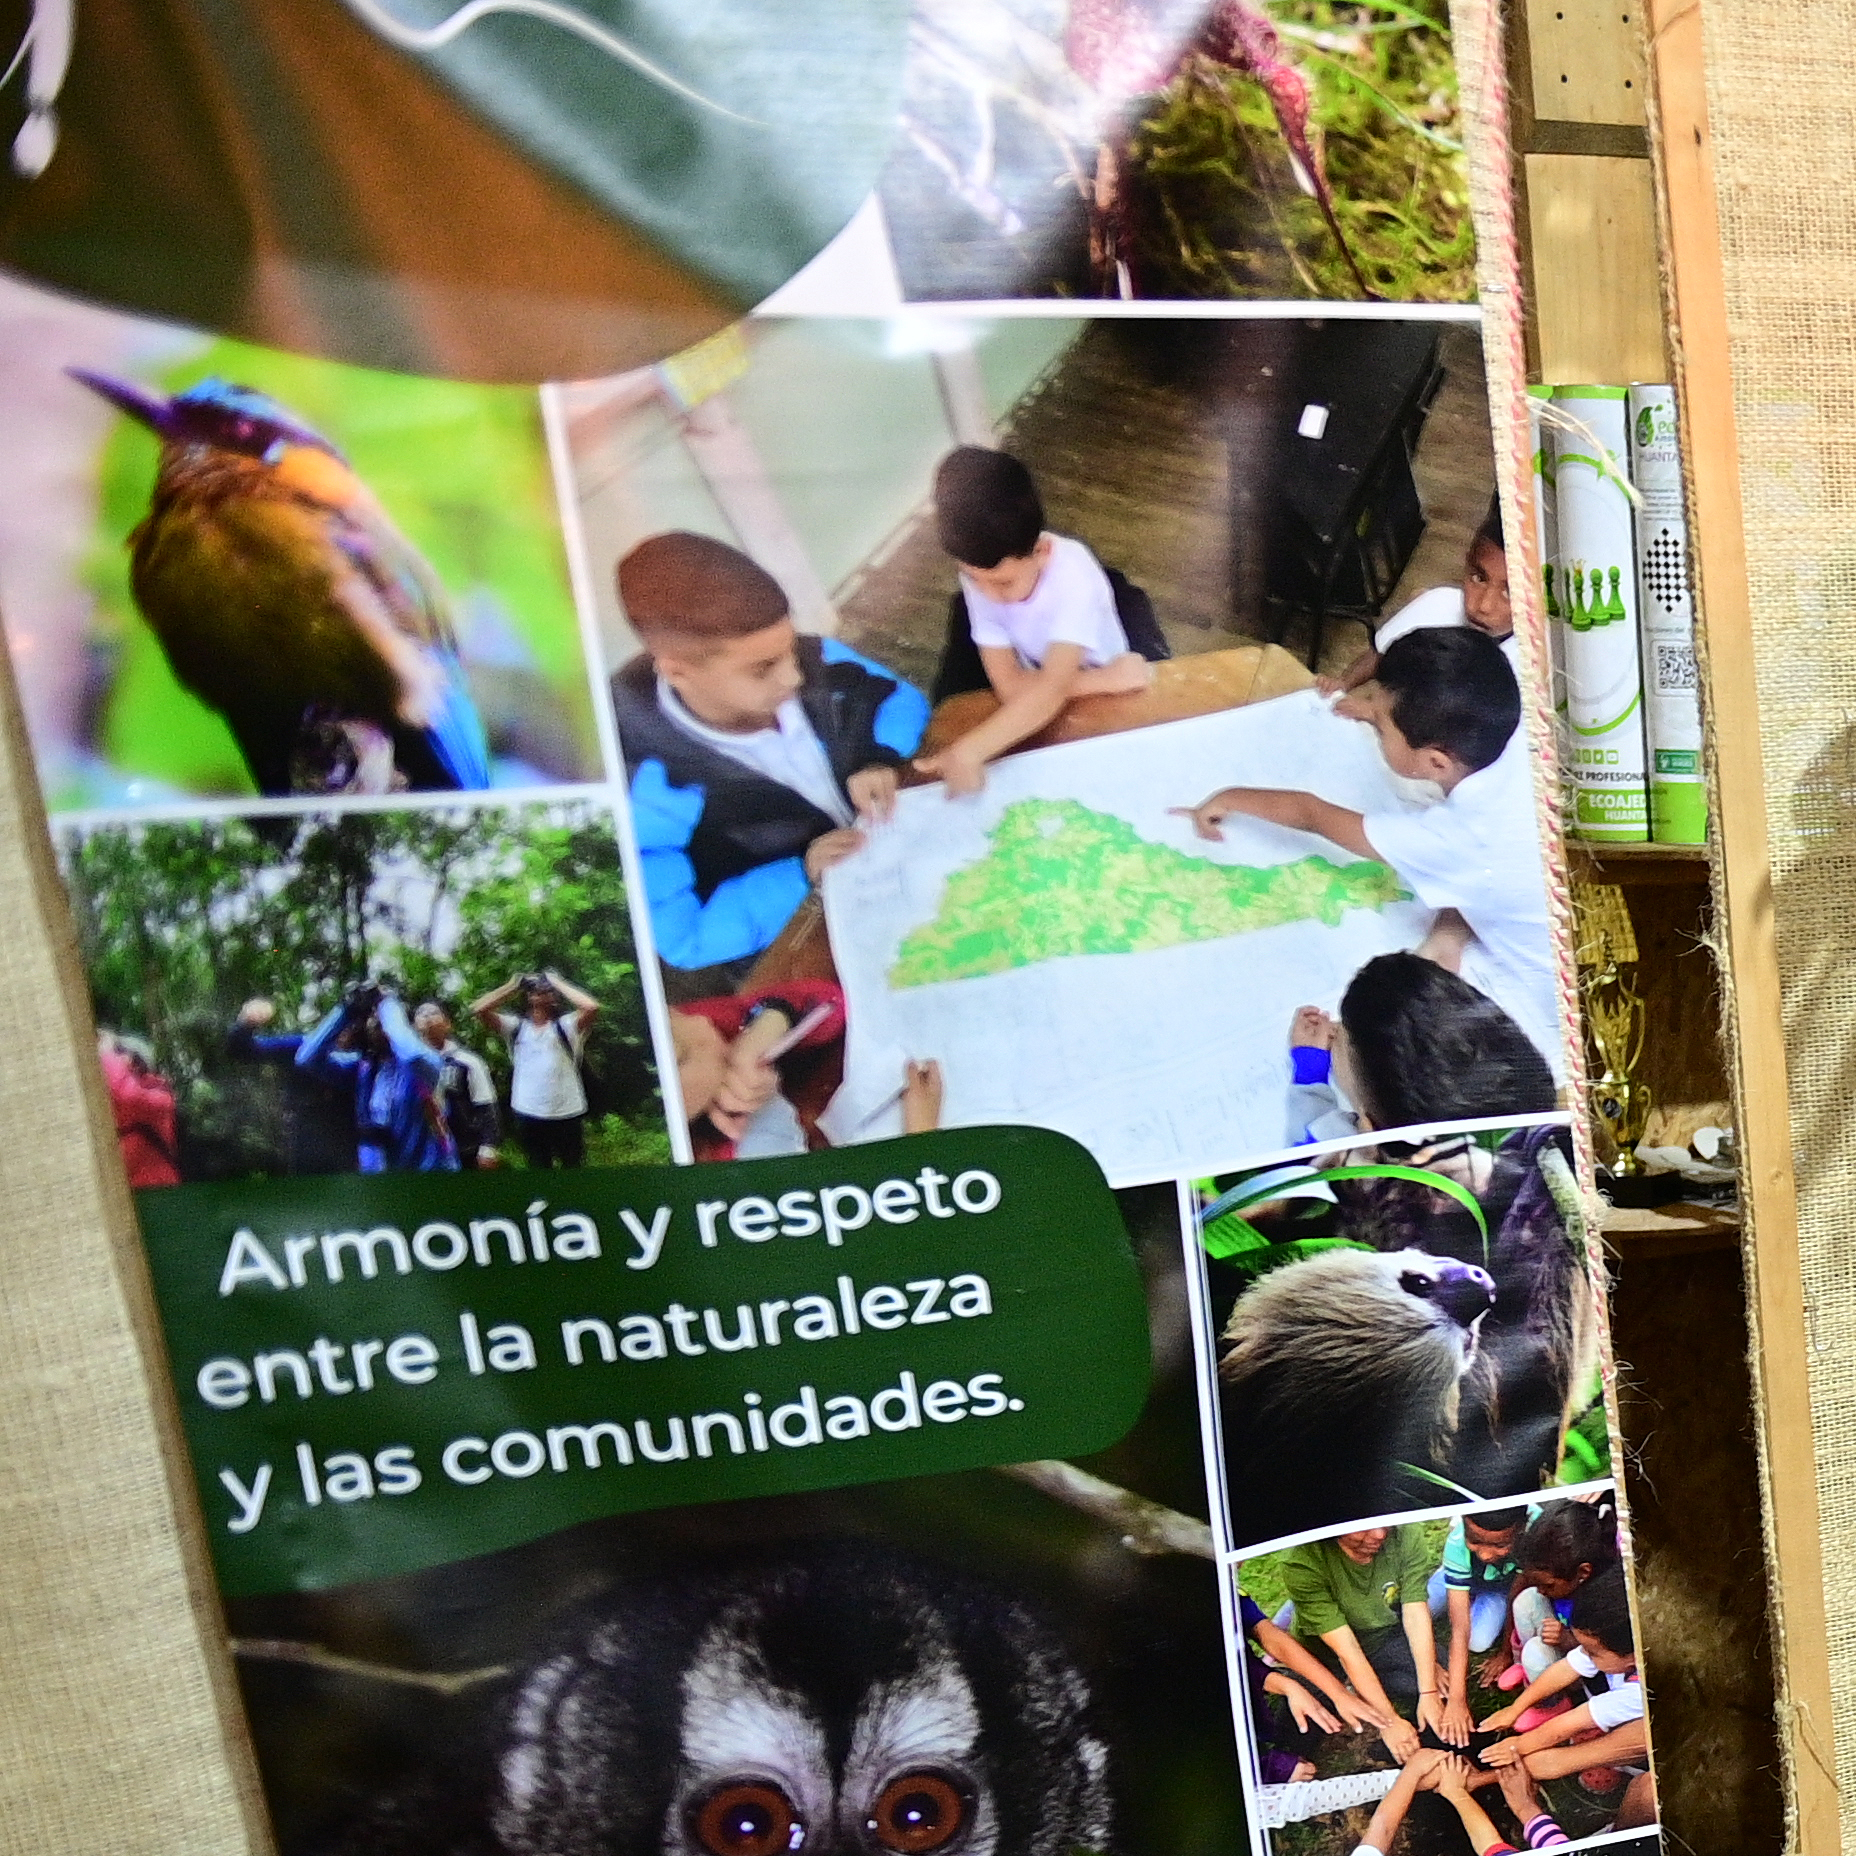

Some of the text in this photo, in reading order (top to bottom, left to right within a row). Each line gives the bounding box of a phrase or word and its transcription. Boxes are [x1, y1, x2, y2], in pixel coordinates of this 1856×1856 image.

[217, 1164, 1003, 1296] Armonía y respeto
[197, 1272, 994, 1408] entre la naturaleza
[217, 1371, 1027, 1535] y las comunidades.
